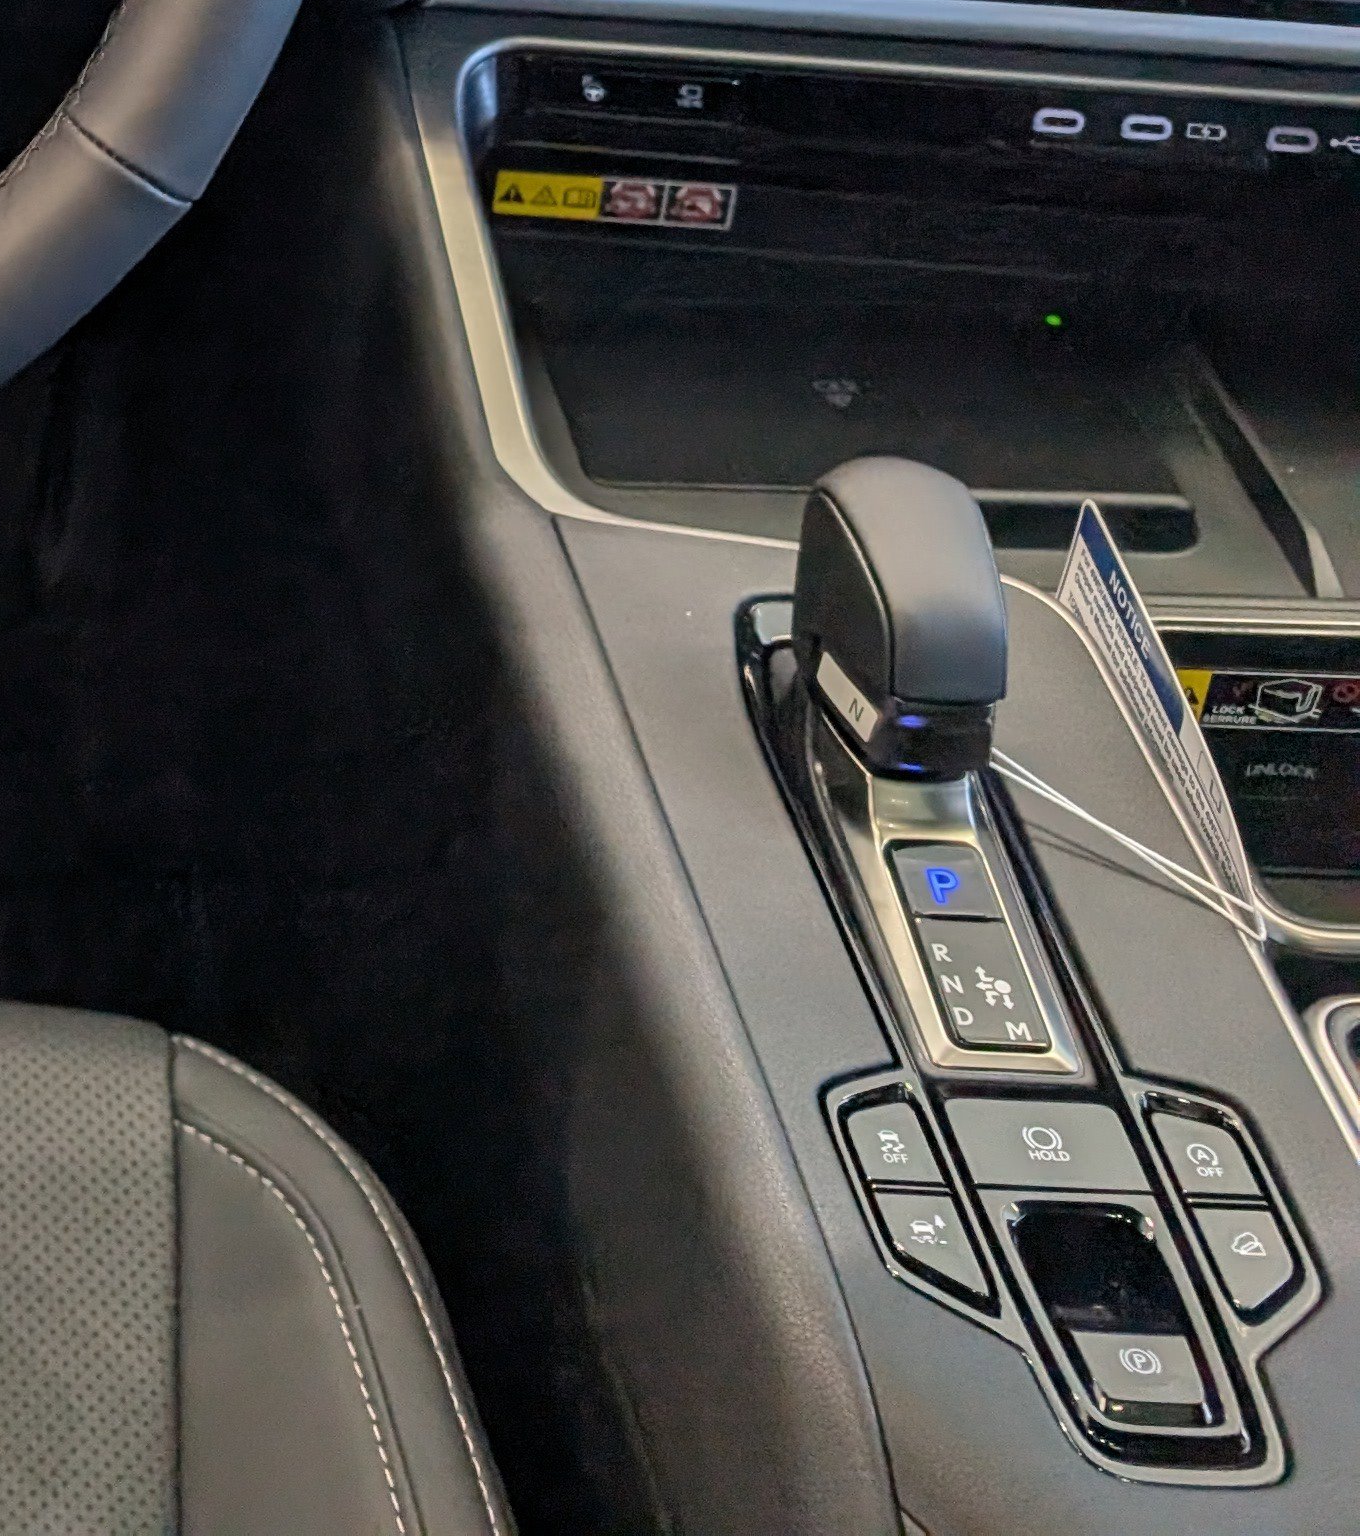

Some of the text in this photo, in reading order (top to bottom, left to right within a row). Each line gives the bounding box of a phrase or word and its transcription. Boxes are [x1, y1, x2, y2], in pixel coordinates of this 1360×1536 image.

[1108, 569, 1151, 660] NOTICE
[849, 697, 865, 722] N
[1211, 705, 1246, 715] LOCK
[926, 868, 960, 904] P
[930, 943, 953, 963] R
[941, 975, 964, 995] N
[953, 1007, 974, 1027] D
[1005, 1022, 1033, 1042] M
[883, 1153, 908, 1164] OFF
[1028, 1150, 1071, 1163] HOLD
[1197, 1167, 1223, 1178] OFF
